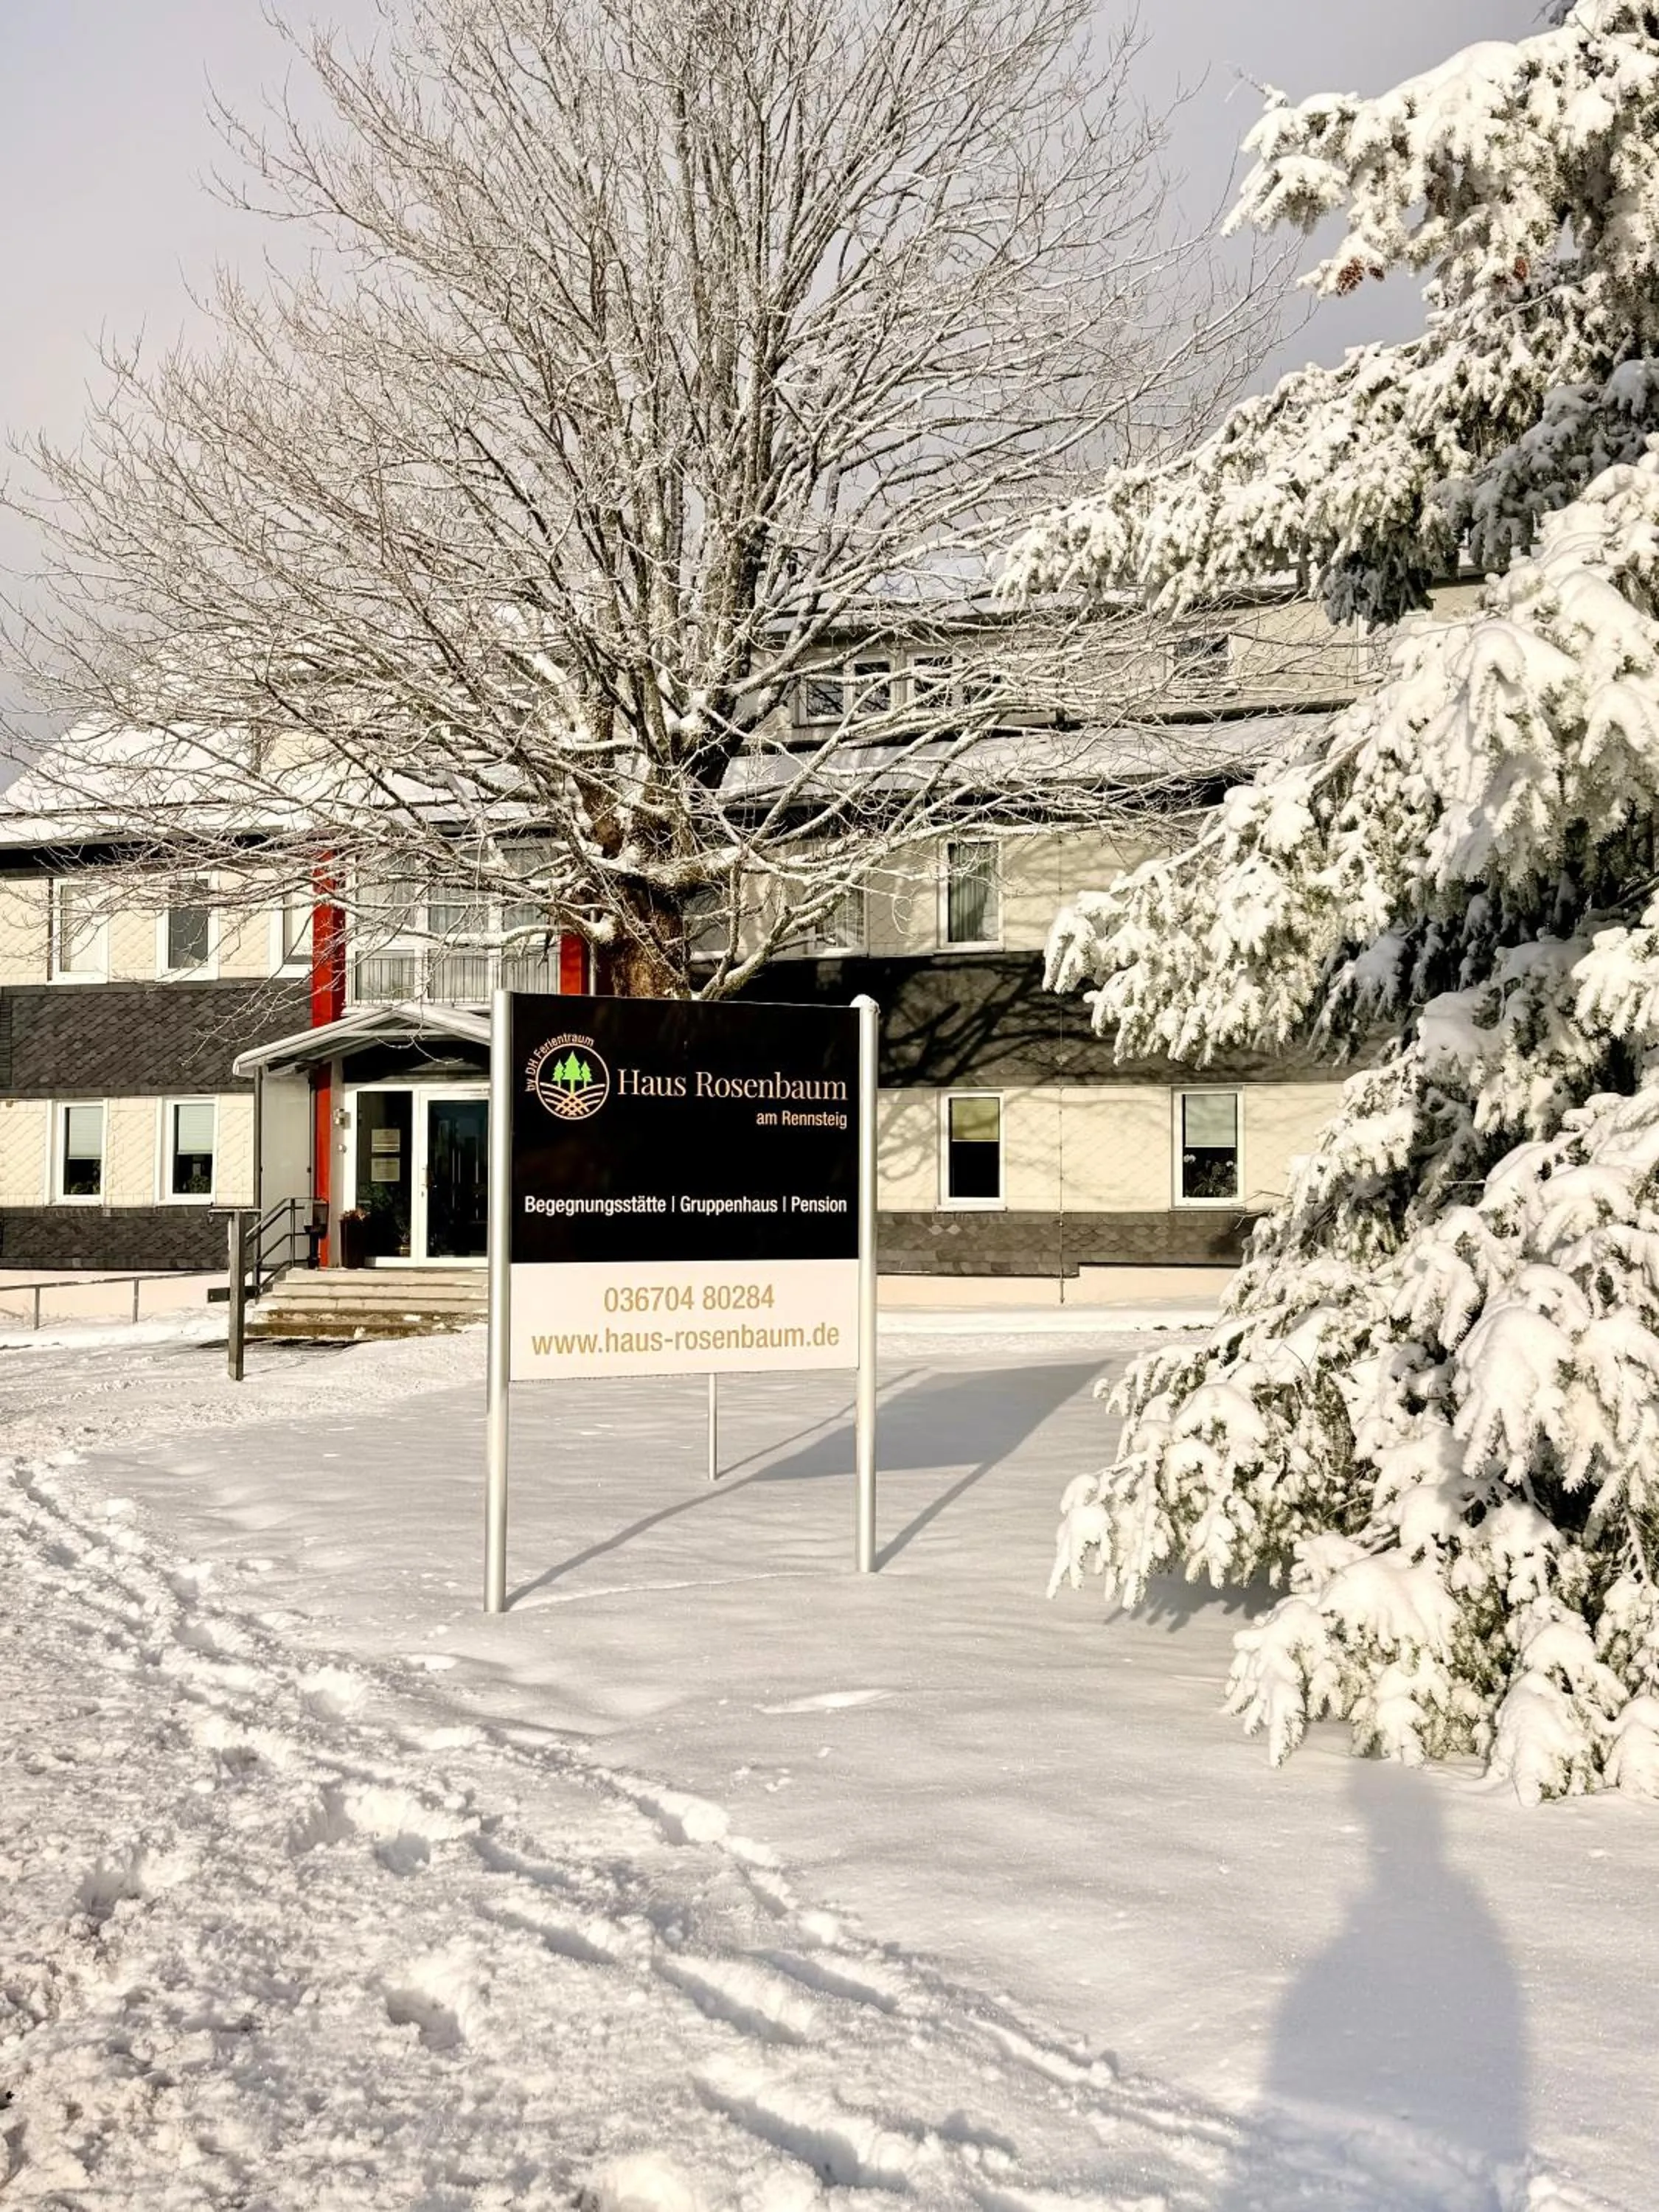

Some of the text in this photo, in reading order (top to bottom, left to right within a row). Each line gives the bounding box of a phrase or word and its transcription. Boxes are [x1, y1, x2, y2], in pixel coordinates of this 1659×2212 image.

[525, 1058, 539, 1075] DH
[533, 1033, 595, 1059] Ferientraum
[617, 1069, 846, 1100] Haus Rosenbaum
[756, 1110, 847, 1129] am Rennsteig
[524, 1195, 666, 1216] Begegnungsstätte
[680, 1195, 779, 1216] Gruppenhaus
[791, 1195, 847, 1213] Pension
[604, 1284, 775, 1312] 036704 80284
[531, 1322, 840, 1356] www.haus-rosenbaum.de
